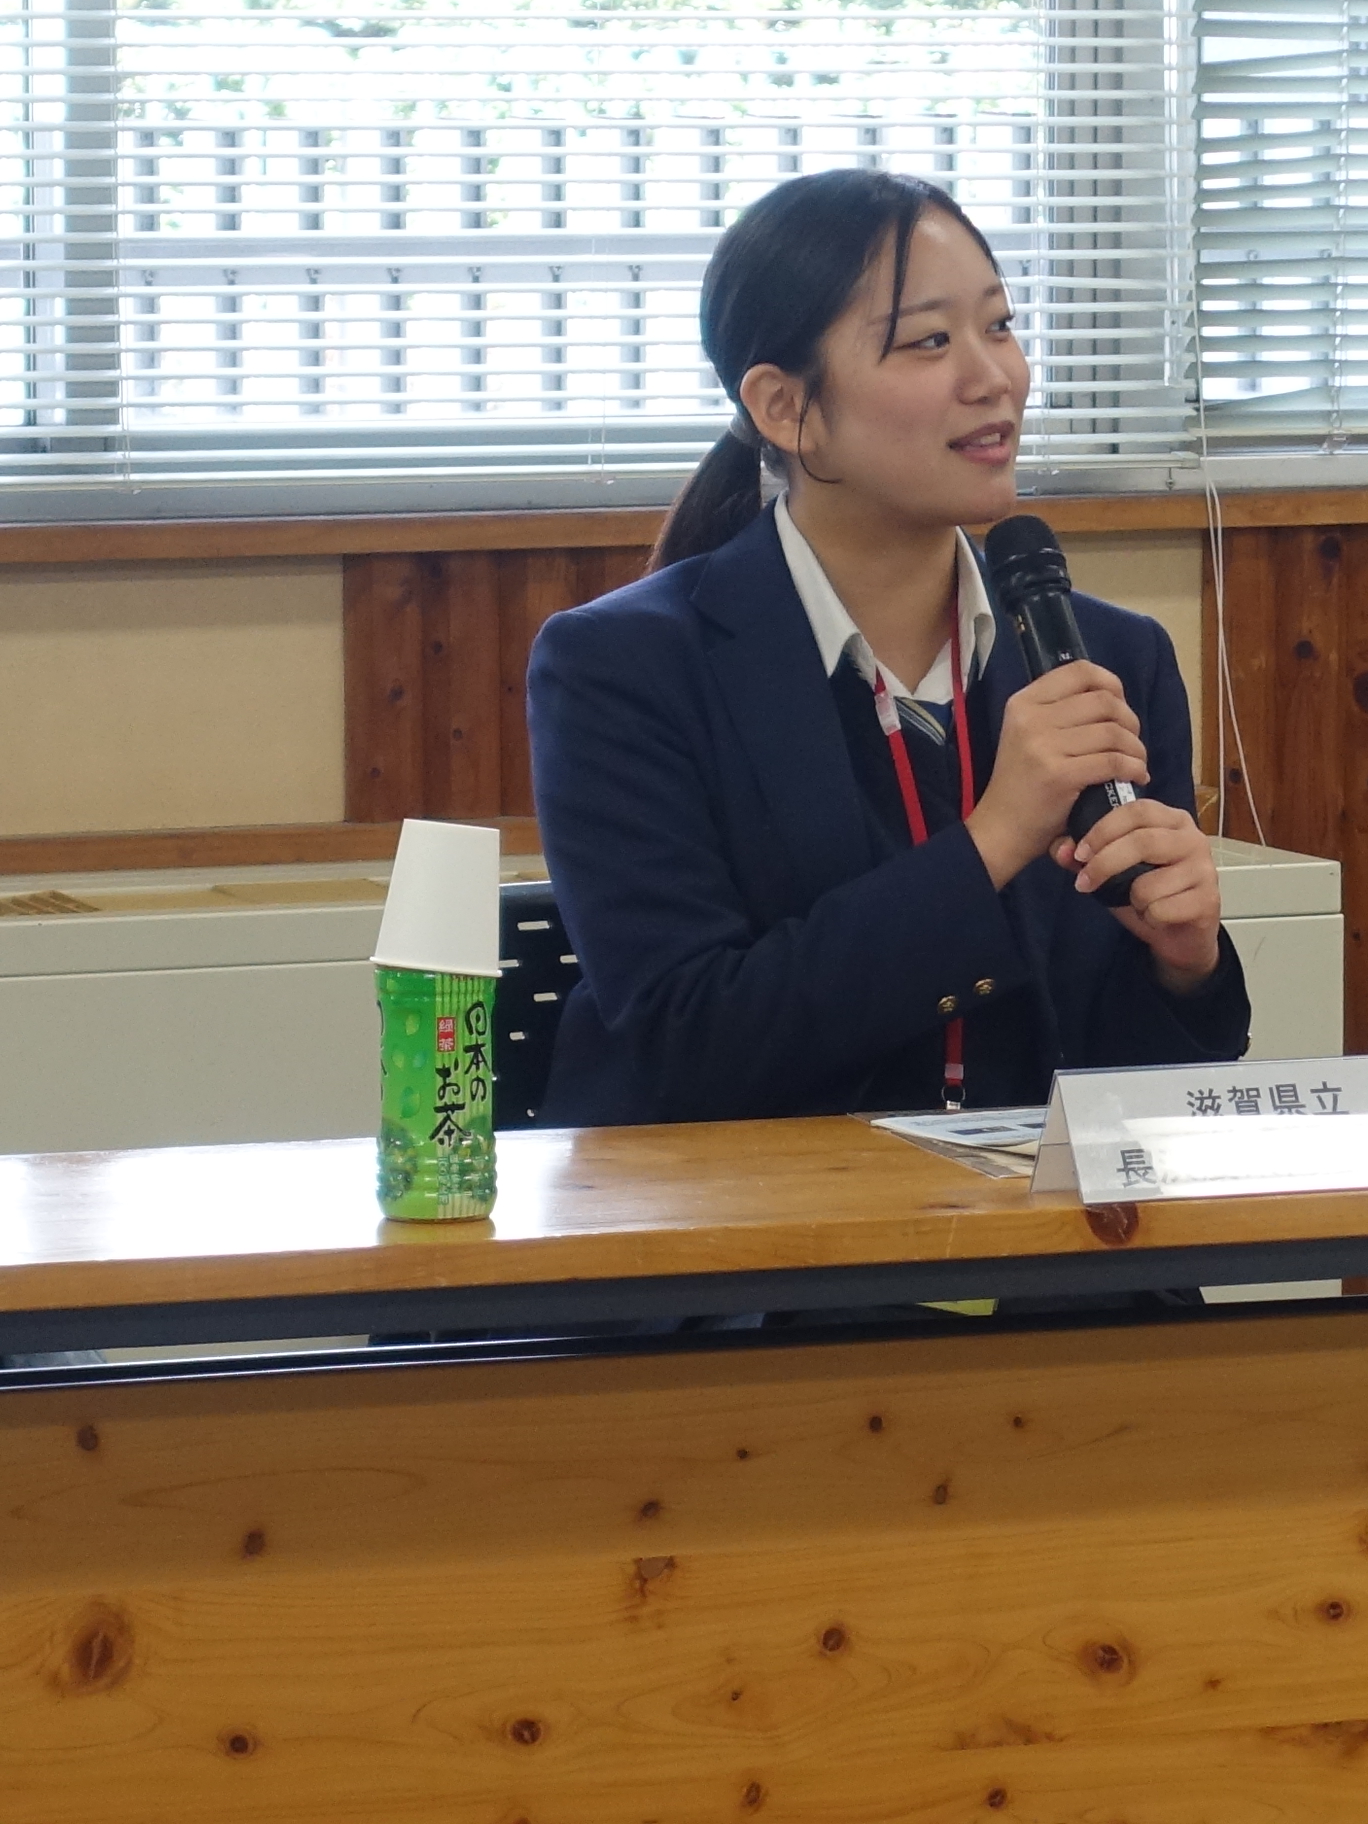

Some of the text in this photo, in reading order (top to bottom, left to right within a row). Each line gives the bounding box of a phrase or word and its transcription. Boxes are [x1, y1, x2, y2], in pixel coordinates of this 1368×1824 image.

[463, 1001, 491, 1102] 日本の
[428, 1057, 473, 1147] お茶
[1186, 1081, 1350, 1117] 滋賀県立
